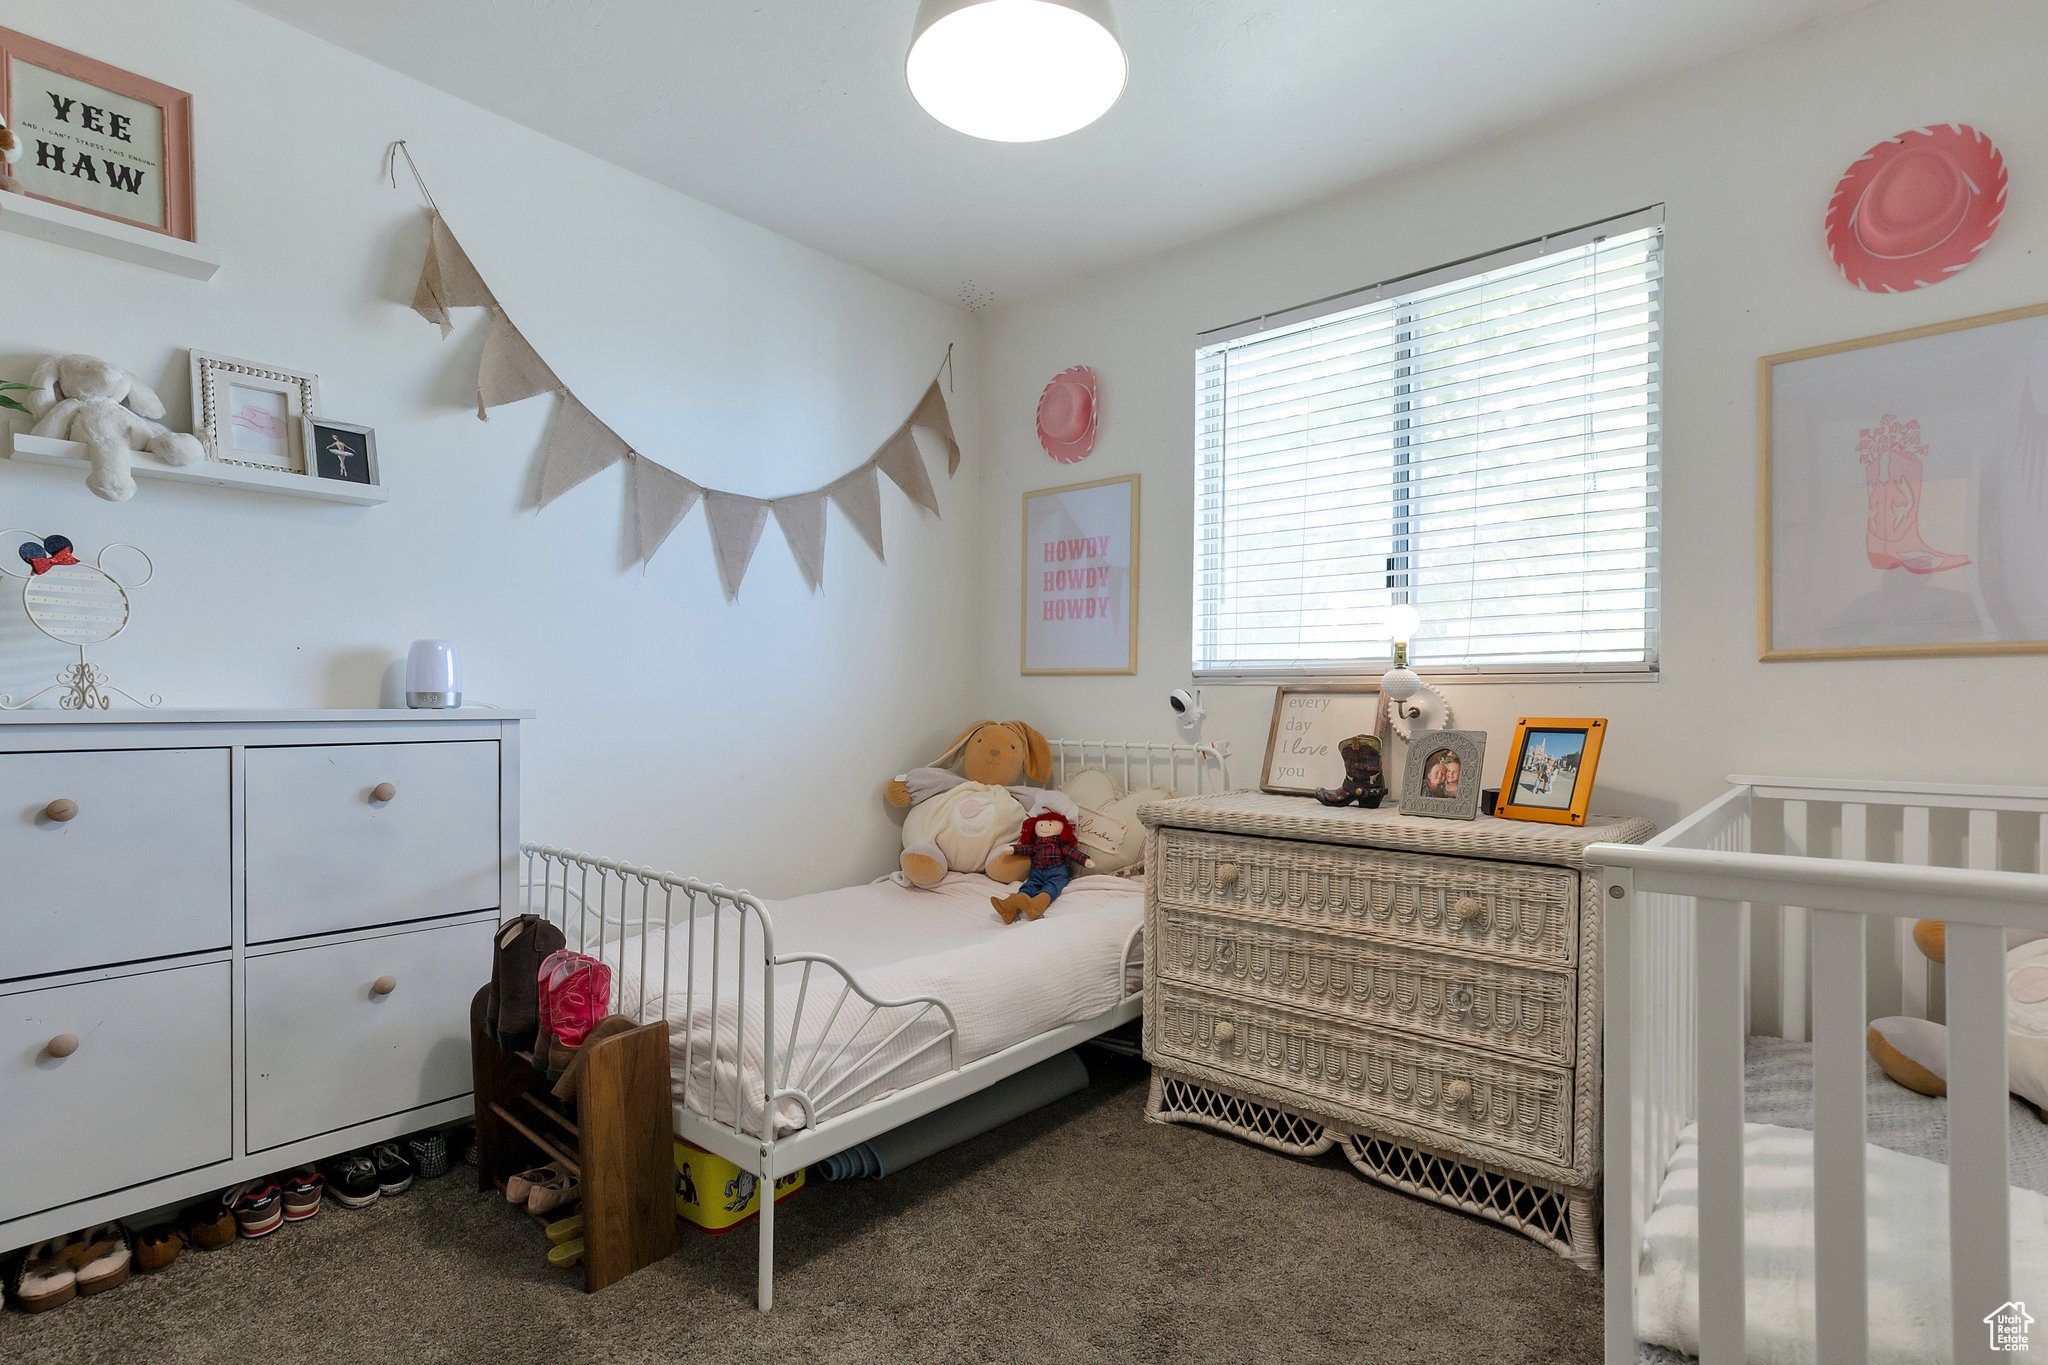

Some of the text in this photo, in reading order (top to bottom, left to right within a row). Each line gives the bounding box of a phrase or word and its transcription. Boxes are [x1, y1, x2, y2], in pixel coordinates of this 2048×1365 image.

[46, 90, 132, 143] YEE
[22, 121, 38, 130] AND
[48, 129, 71, 140] CAN'T
[75, 137, 105, 152] STRESS
[108, 147, 125, 159] THIS
[128, 154, 156, 168] ENOUGH
[35, 139, 145, 195] HAW
[1043, 535, 1111, 563] HOWDY
[1043, 565, 1111, 592] HOWDY
[1042, 597, 1111, 621] HOWDY
[1289, 698, 1331, 712] every
[1285, 717, 1312, 735] day
[1282, 737, 1329, 756] I love
[1277, 766, 1305, 781] you
